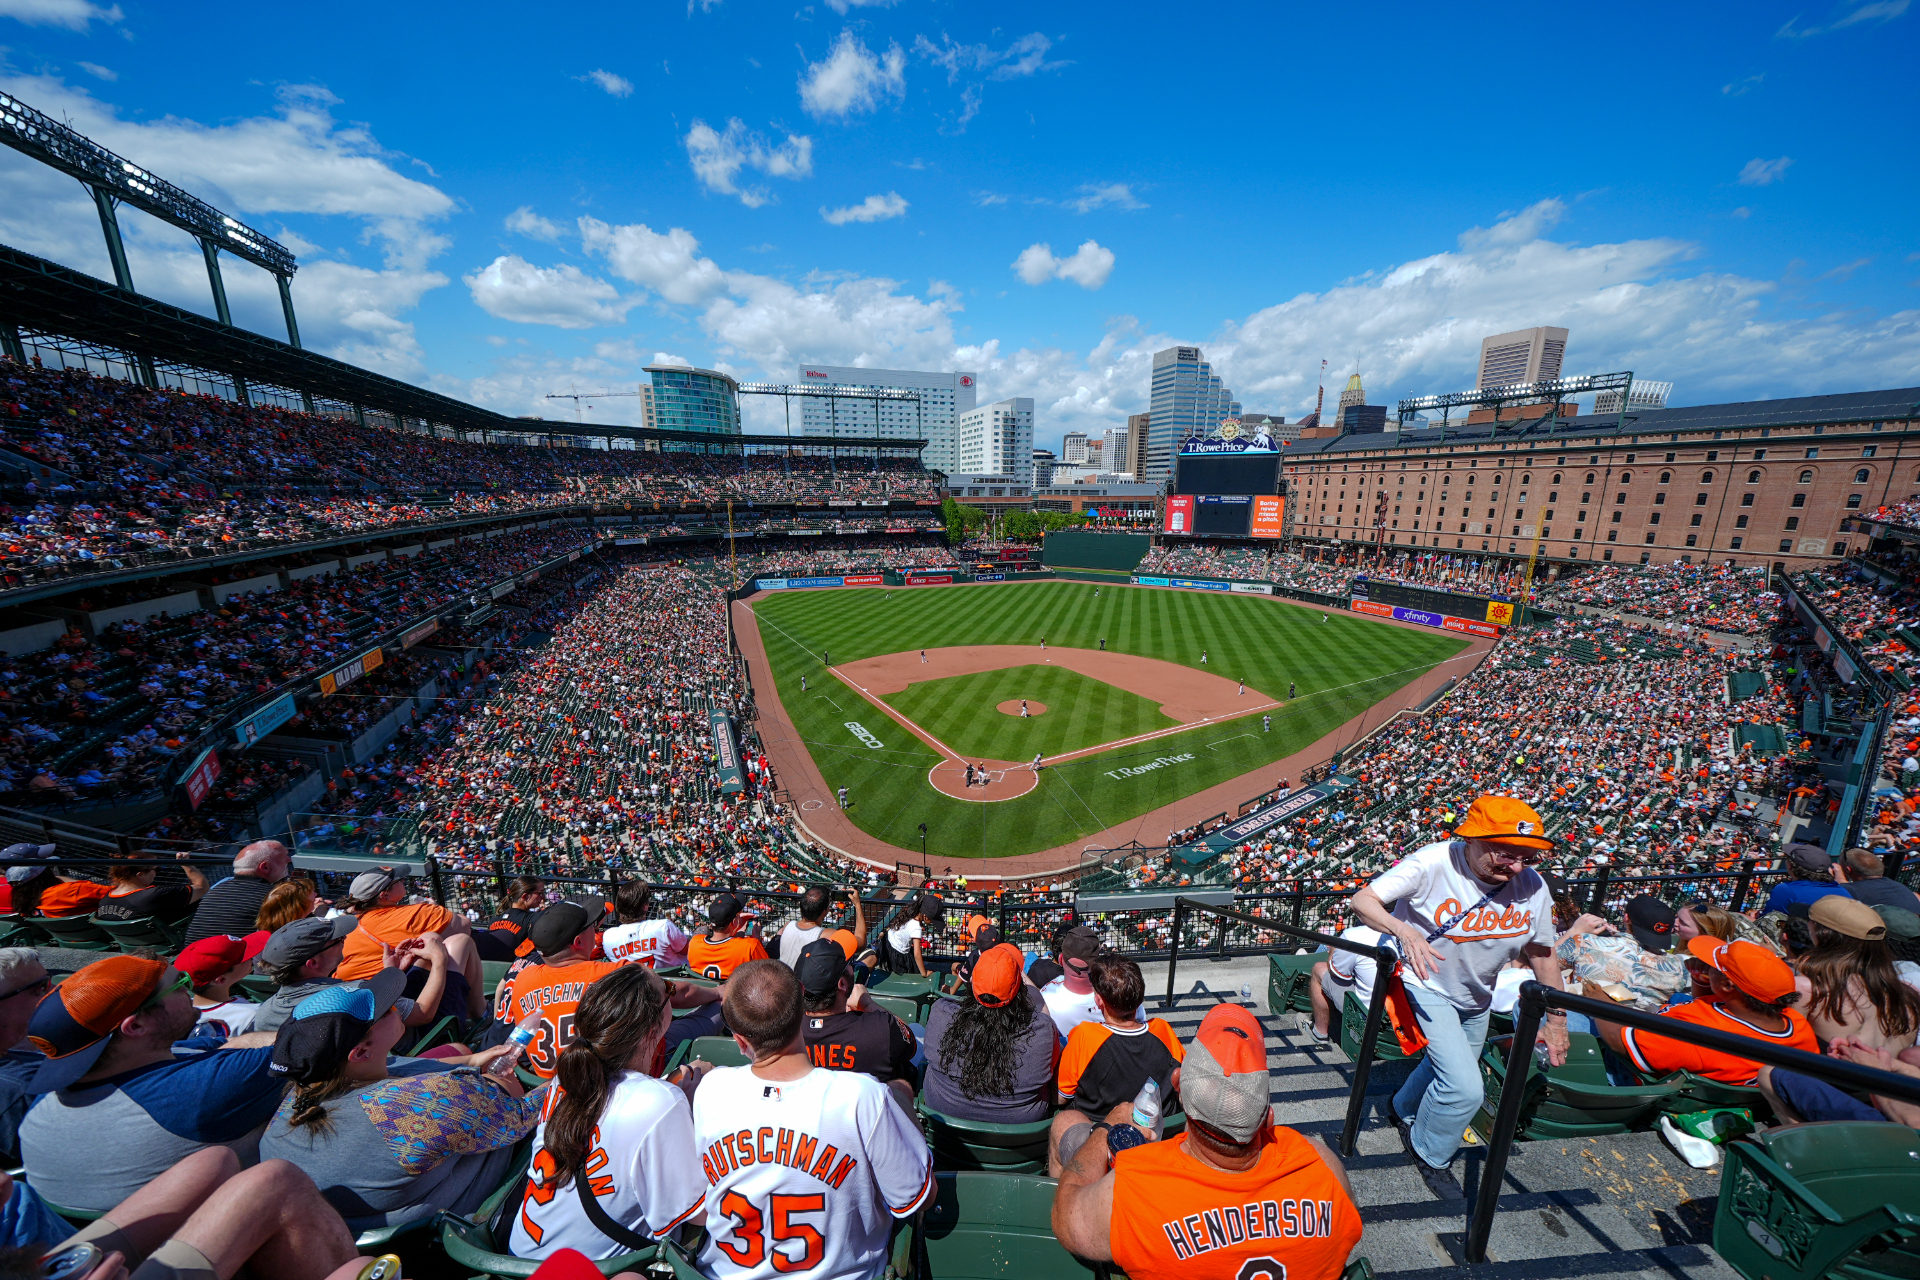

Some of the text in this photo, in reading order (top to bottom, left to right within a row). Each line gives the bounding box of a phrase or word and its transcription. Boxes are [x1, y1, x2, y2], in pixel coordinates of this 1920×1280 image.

[806, 370, 828, 378] Hilton
[1099, 505, 1156, 518] Coors LIGHT
[1403, 610, 1432, 623] xfinity
[335, 670, 350, 687] OLD
[349, 660, 363, 678] BAY
[844, 721, 885, 749] GEICO
[612, 937, 657, 960] COWSER
[702, 1126, 858, 1190] RUTSCHMAN
[716, 1187, 826, 1274] 35
[1162, 1198, 1333, 1261] HENDERSON
[1759, 1234, 1770, 1245] 4
